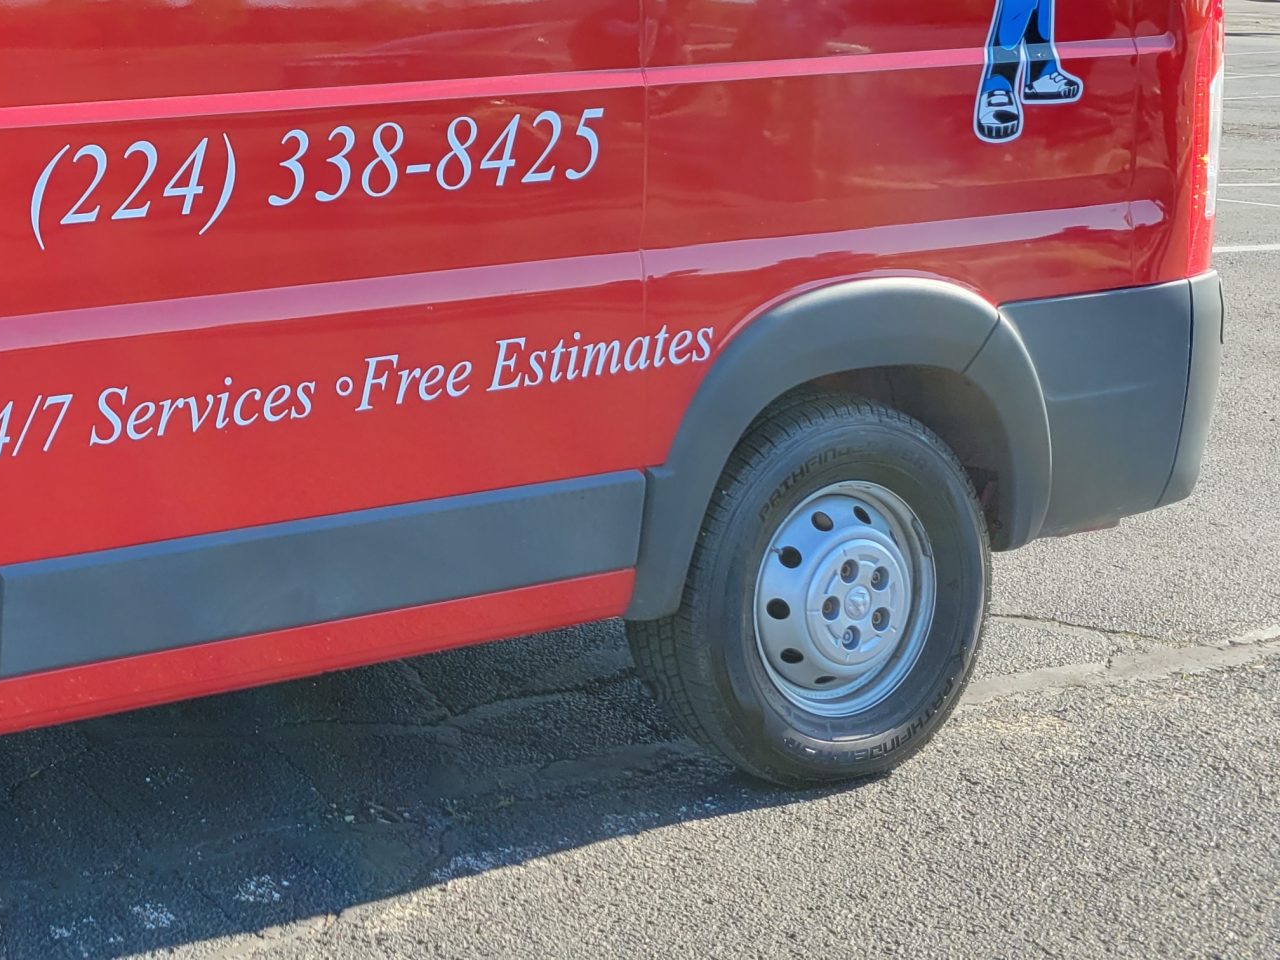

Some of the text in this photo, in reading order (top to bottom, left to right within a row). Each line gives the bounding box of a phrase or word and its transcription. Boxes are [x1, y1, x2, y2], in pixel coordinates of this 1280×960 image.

[29, 106, 605, 251] (224) 338-8425
[88, 375, 317, 448] Services
[485, 323, 715, 393] Estimates
